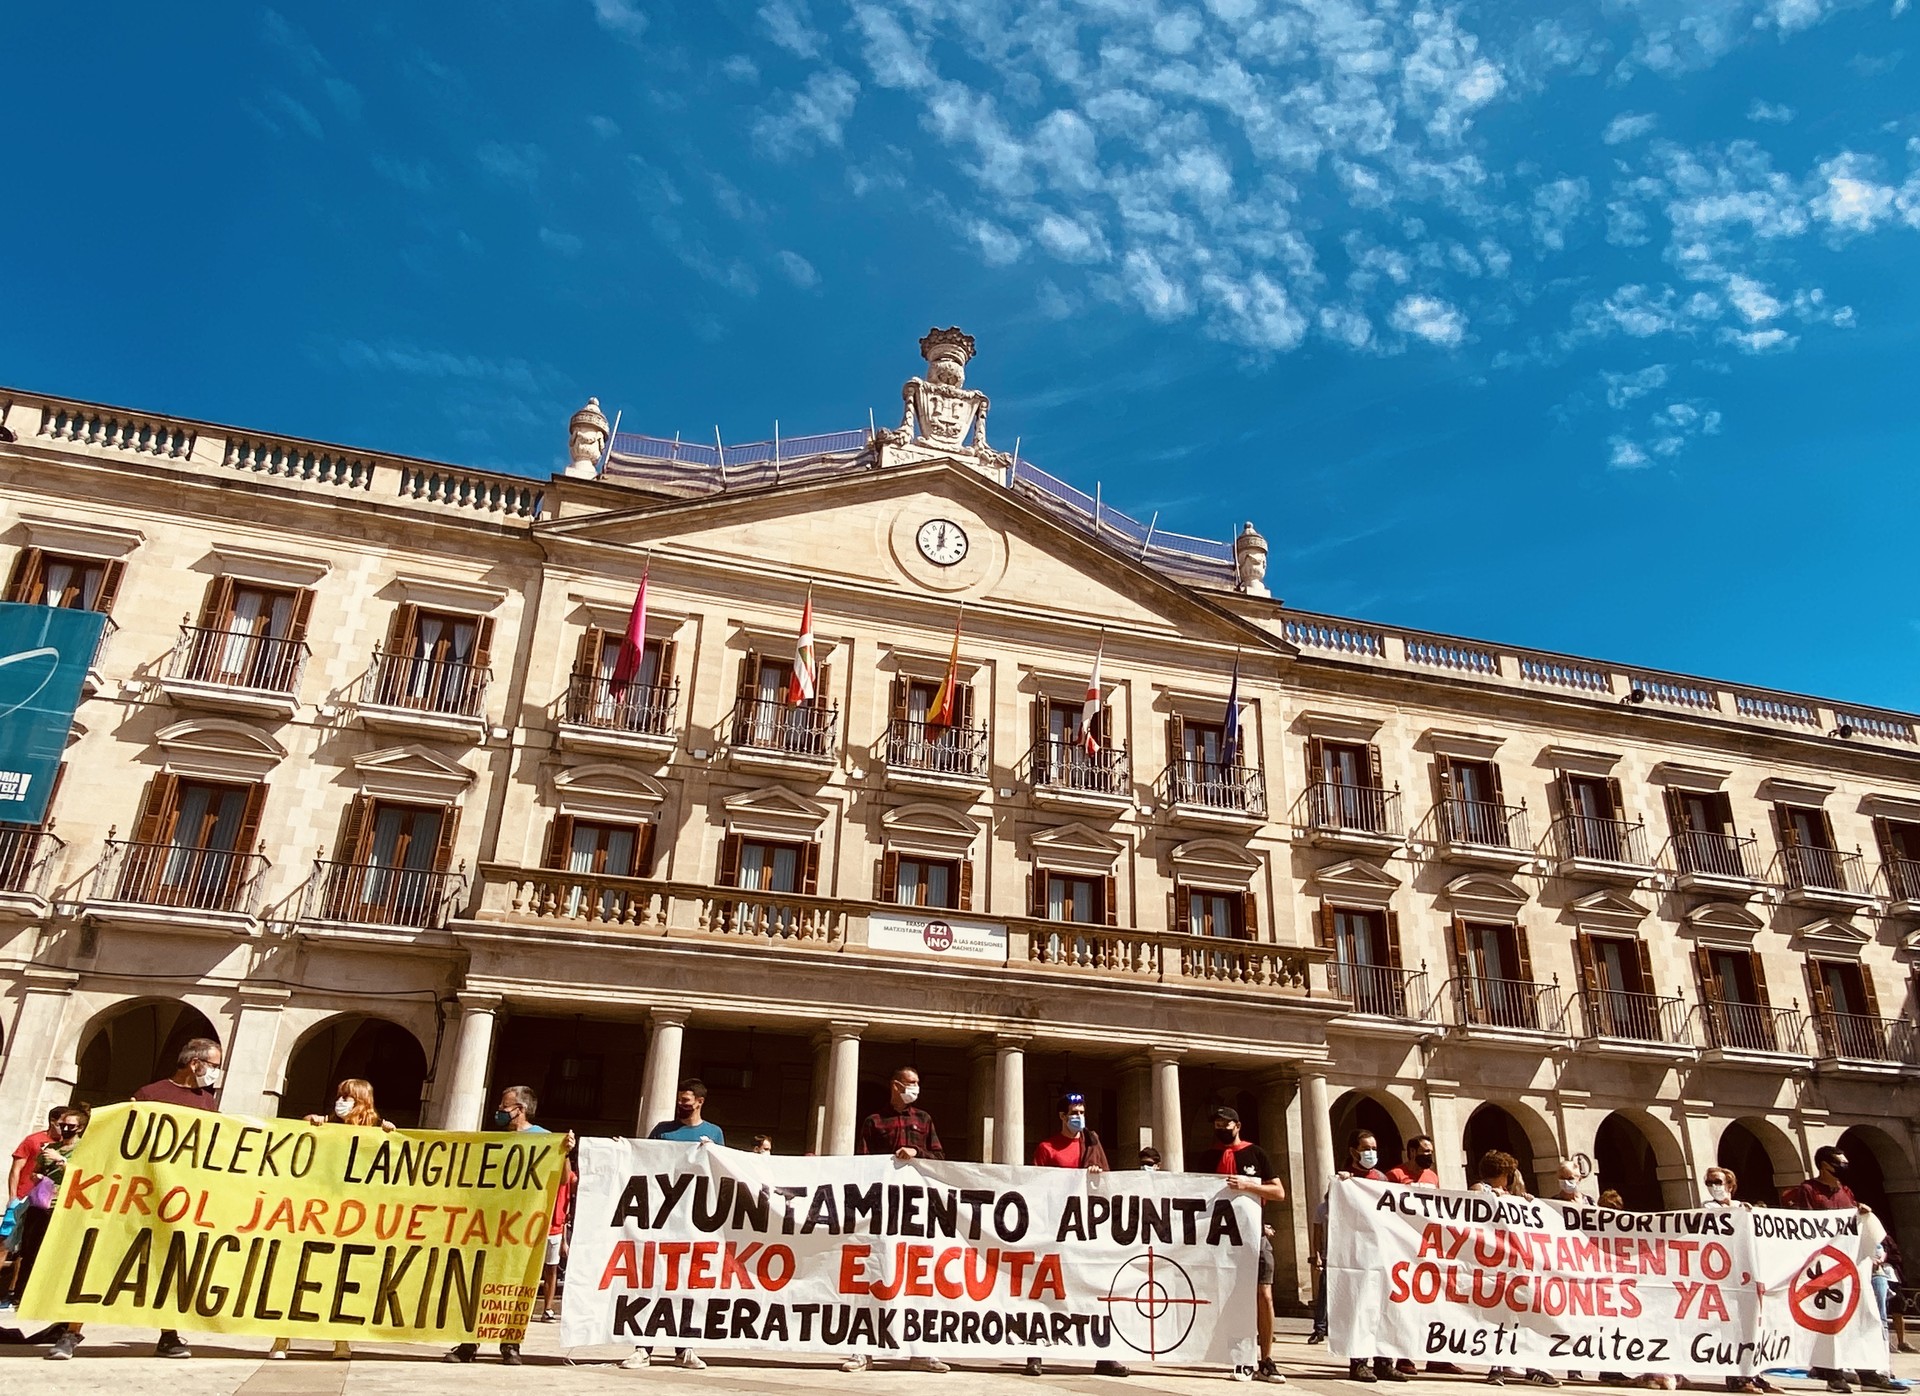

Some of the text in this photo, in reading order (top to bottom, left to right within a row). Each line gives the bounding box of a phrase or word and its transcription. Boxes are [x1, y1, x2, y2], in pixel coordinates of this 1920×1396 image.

[930, 925, 947, 935] EZ!
[120, 1109, 551, 1191] UDALEKO LANGILEOK
[610, 1173, 1243, 1246] AYUNTAMIENTO APUNTA
[1376, 1189, 1544, 1228] ACTIVIDADES
[1562, 1206, 1735, 1236] DEPORTIVAS
[66, 1227, 487, 1332] LANGILEEKIN
[483, 1284, 536, 1298] GASTEIZKO
[598, 1240, 1066, 1301] AITEKO EJECUTA
[1389, 1261, 1642, 1319] SOLUCIONES
[481, 1299, 530, 1312] UDALEKO
[613, 1295, 1111, 1349] KALERATUAK BERRONARTU
[1425, 1321, 1519, 1356] Busti
[1549, 1326, 1671, 1363] zaitez
